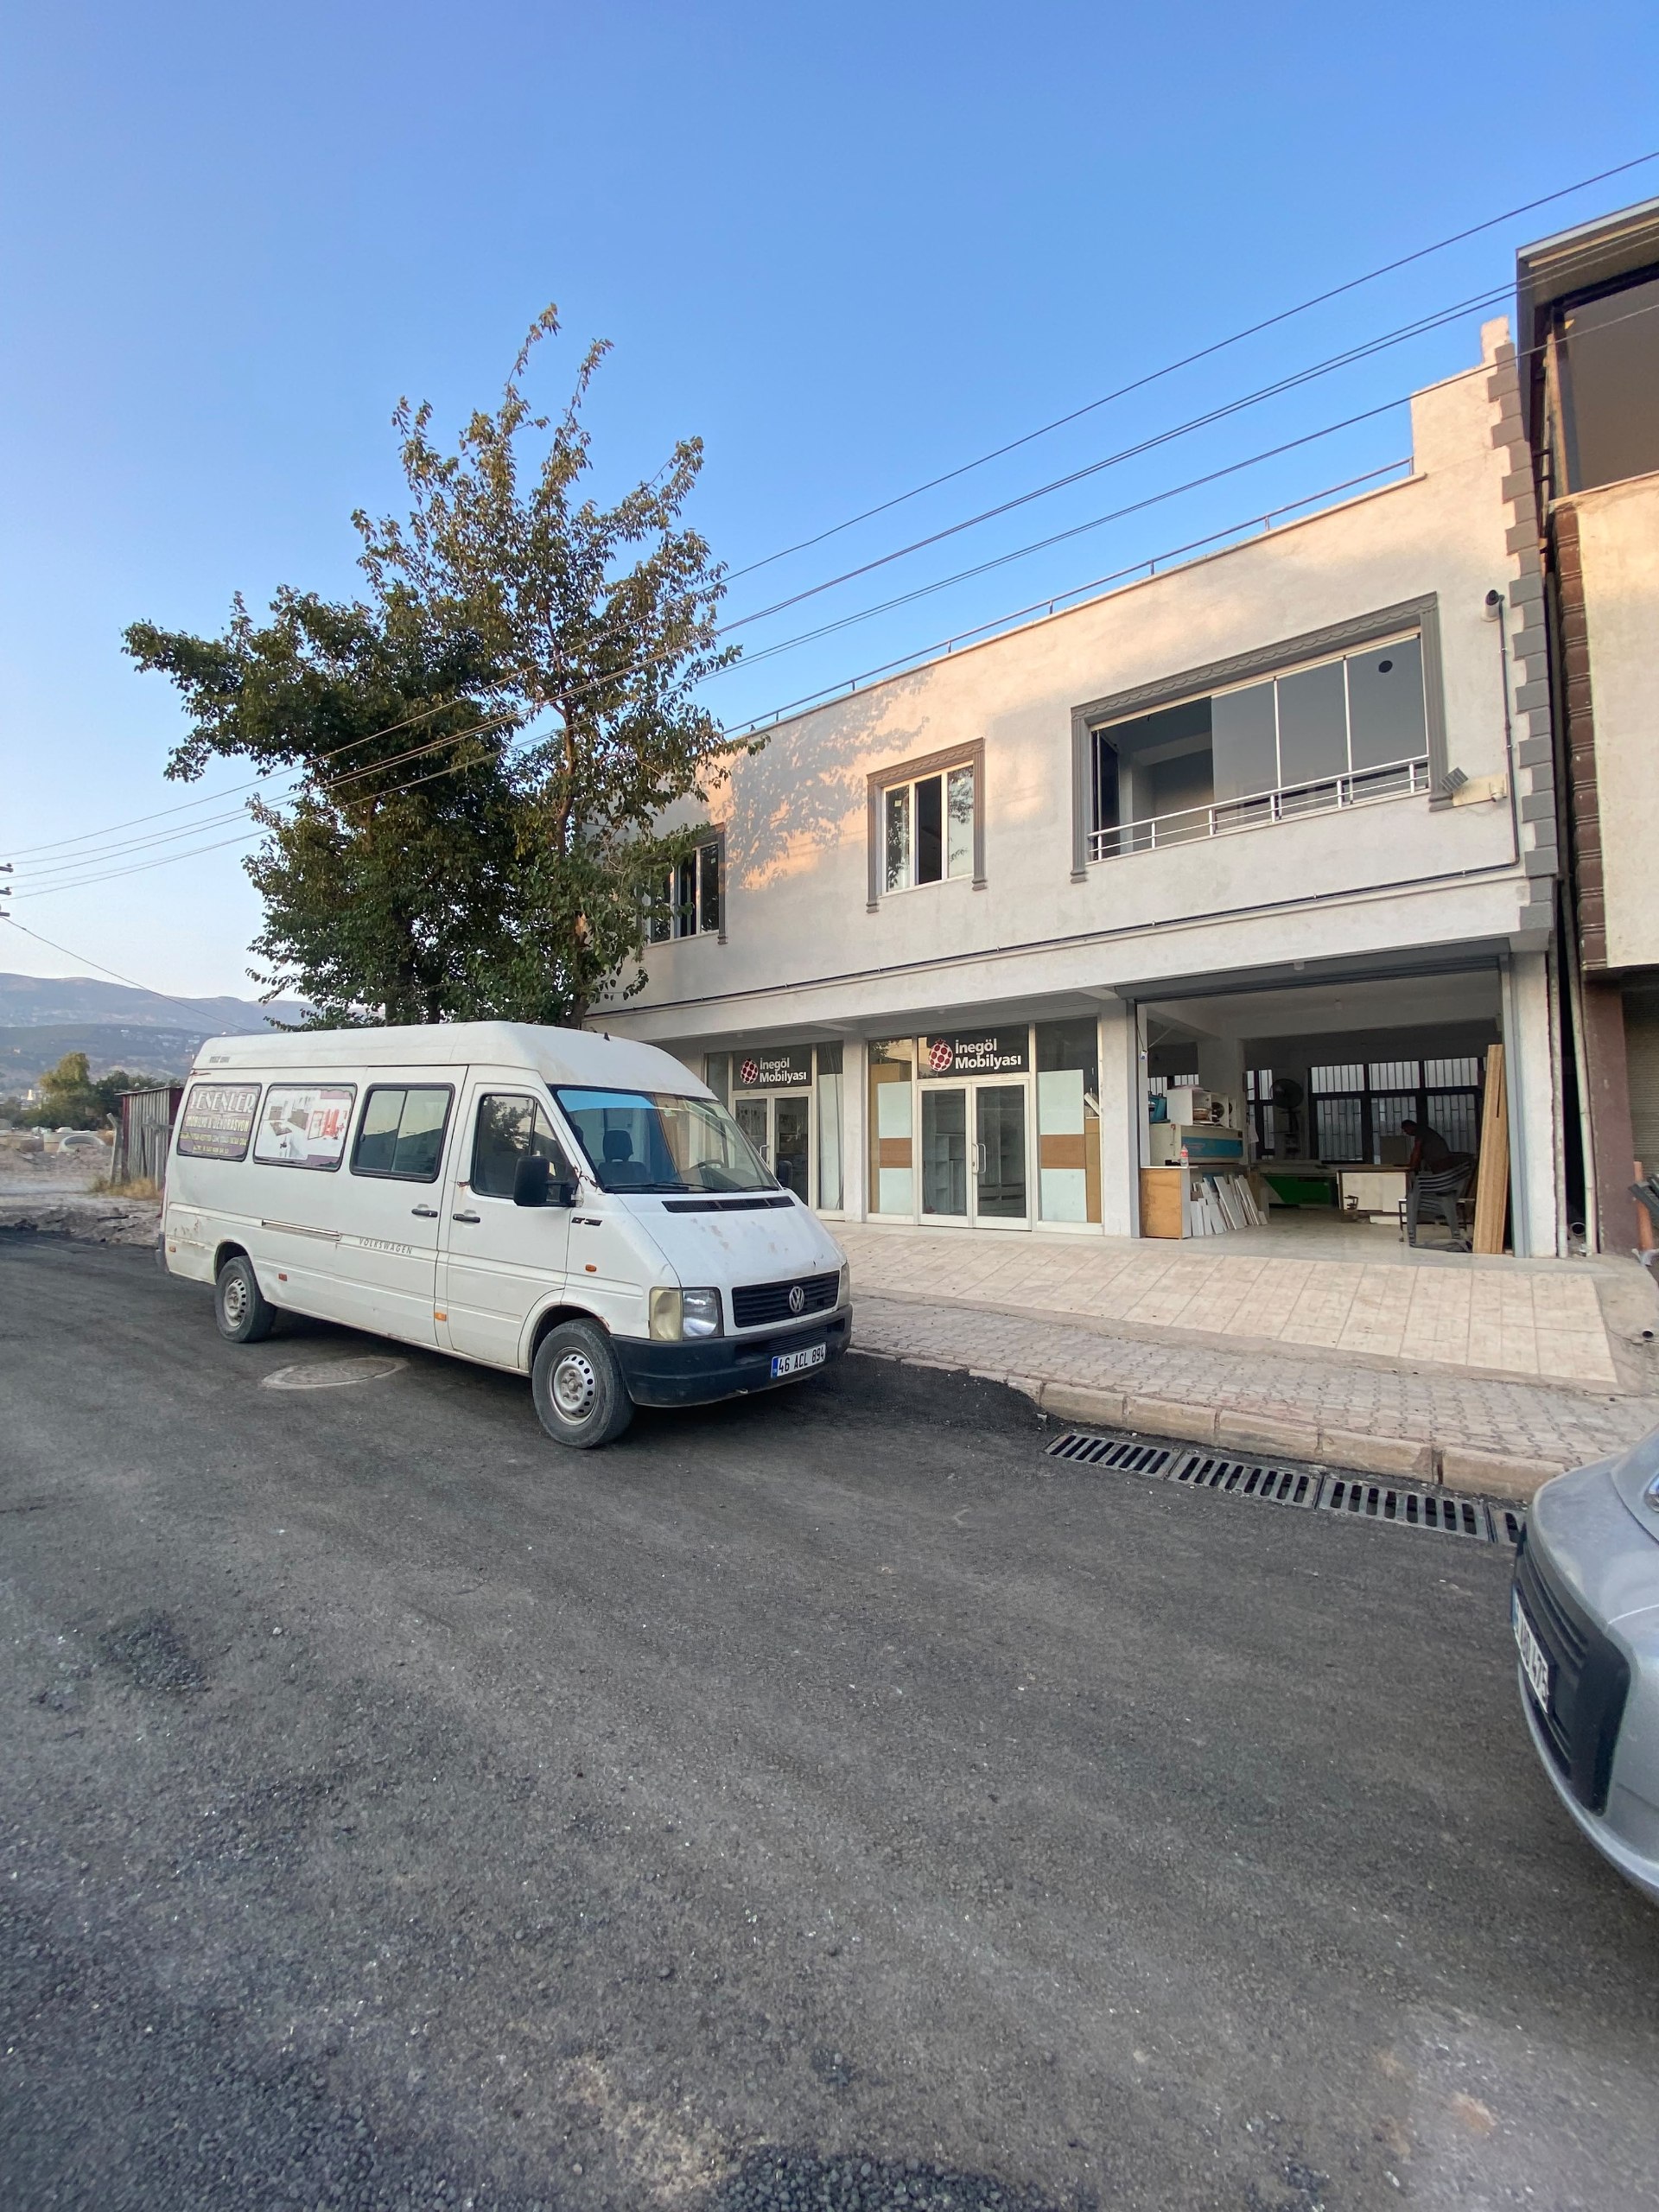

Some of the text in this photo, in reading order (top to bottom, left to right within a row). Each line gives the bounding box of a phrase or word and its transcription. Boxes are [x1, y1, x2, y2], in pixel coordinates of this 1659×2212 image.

[955, 1038, 997, 1055] İnegöl
[760, 1057, 790, 1071] İnegöl
[955, 1054, 1021, 1070] Mobilyası
[760, 1071, 807, 1084] Mobilyası
[359, 1236, 413, 1255] VOLKSWAGEN
[779, 1346, 824, 1373] 46 ACL 894
